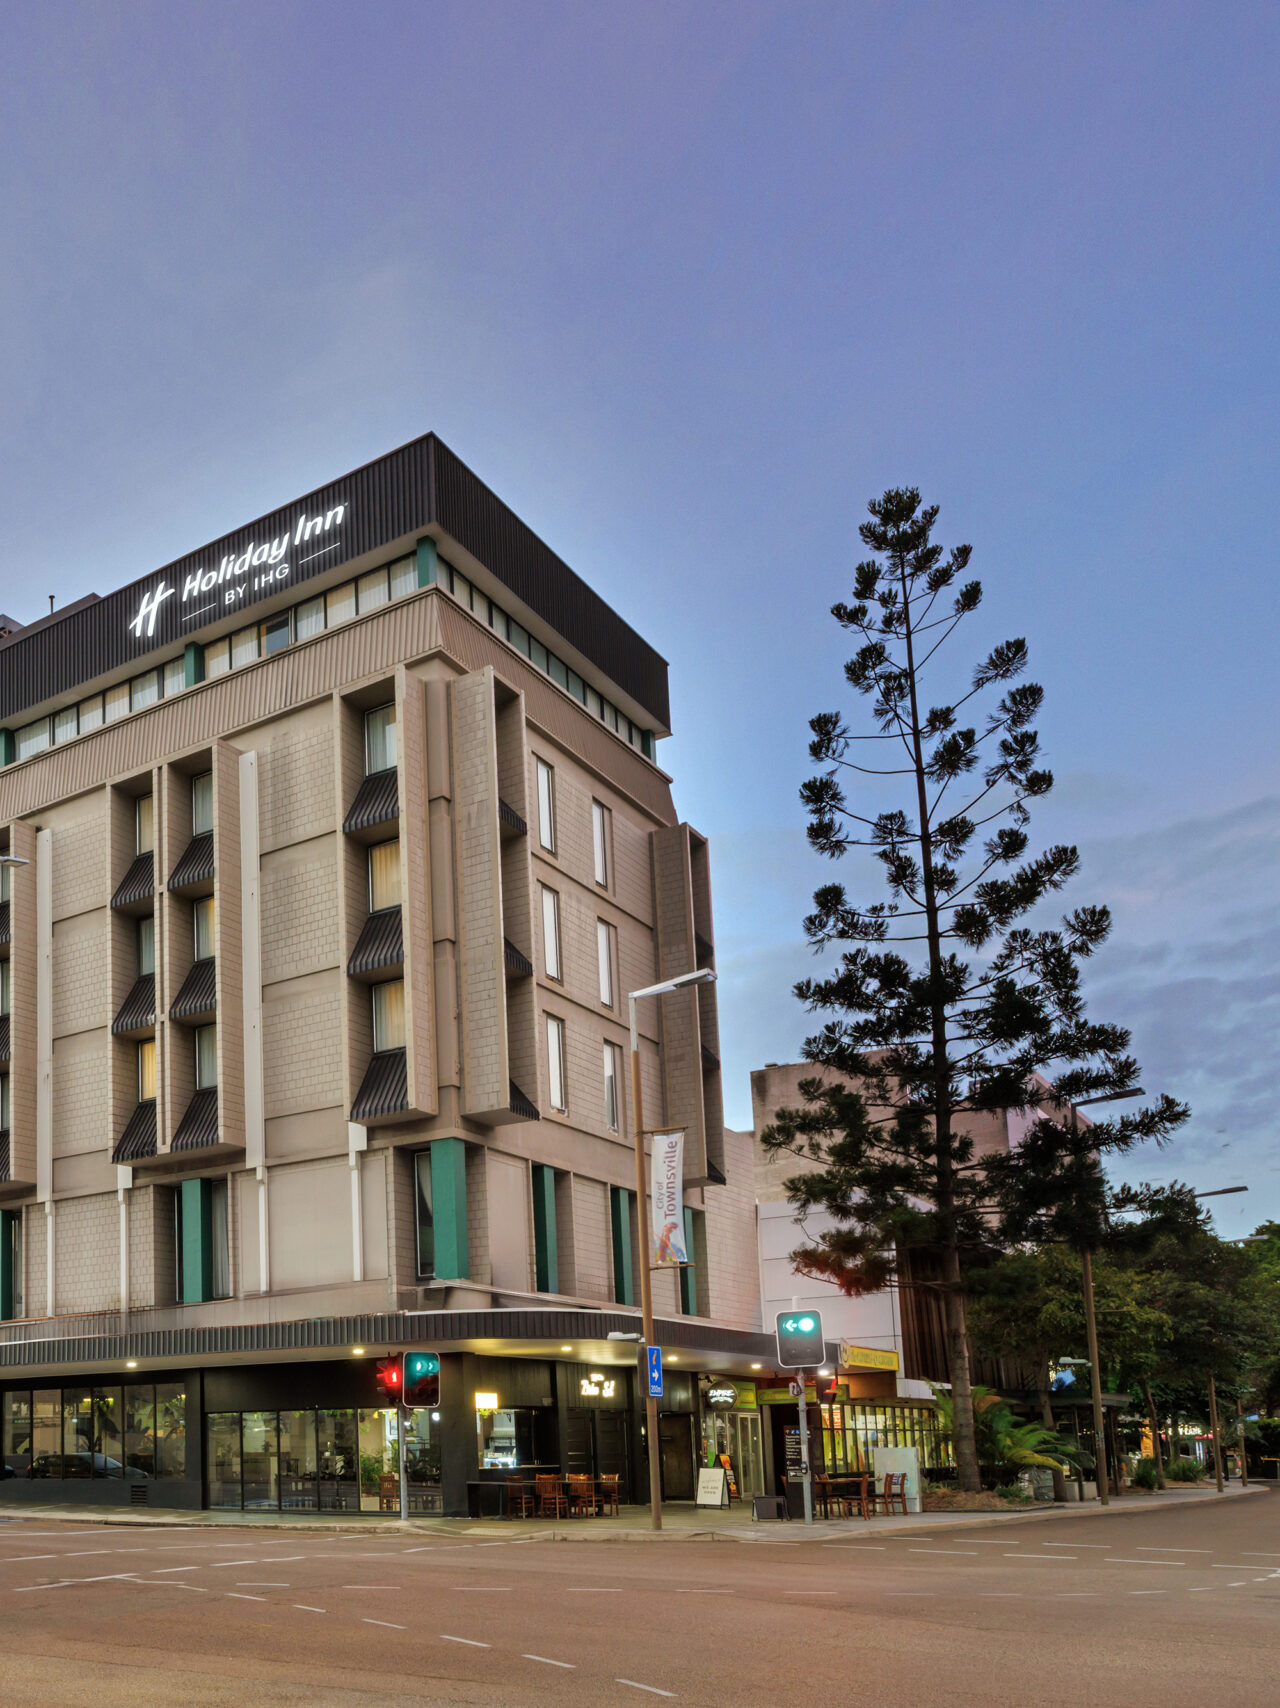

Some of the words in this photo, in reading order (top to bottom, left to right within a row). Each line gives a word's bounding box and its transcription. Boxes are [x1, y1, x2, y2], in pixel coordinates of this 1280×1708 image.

[182, 531, 290, 602] Holiday
[293, 504, 345, 545] Inn
[224, 583, 247, 605] BY
[253, 563, 290, 592] IHG
[656, 1181, 664, 1190] of
[656, 1192, 665, 1210] City
[664, 1140, 678, 1221] Townsville
